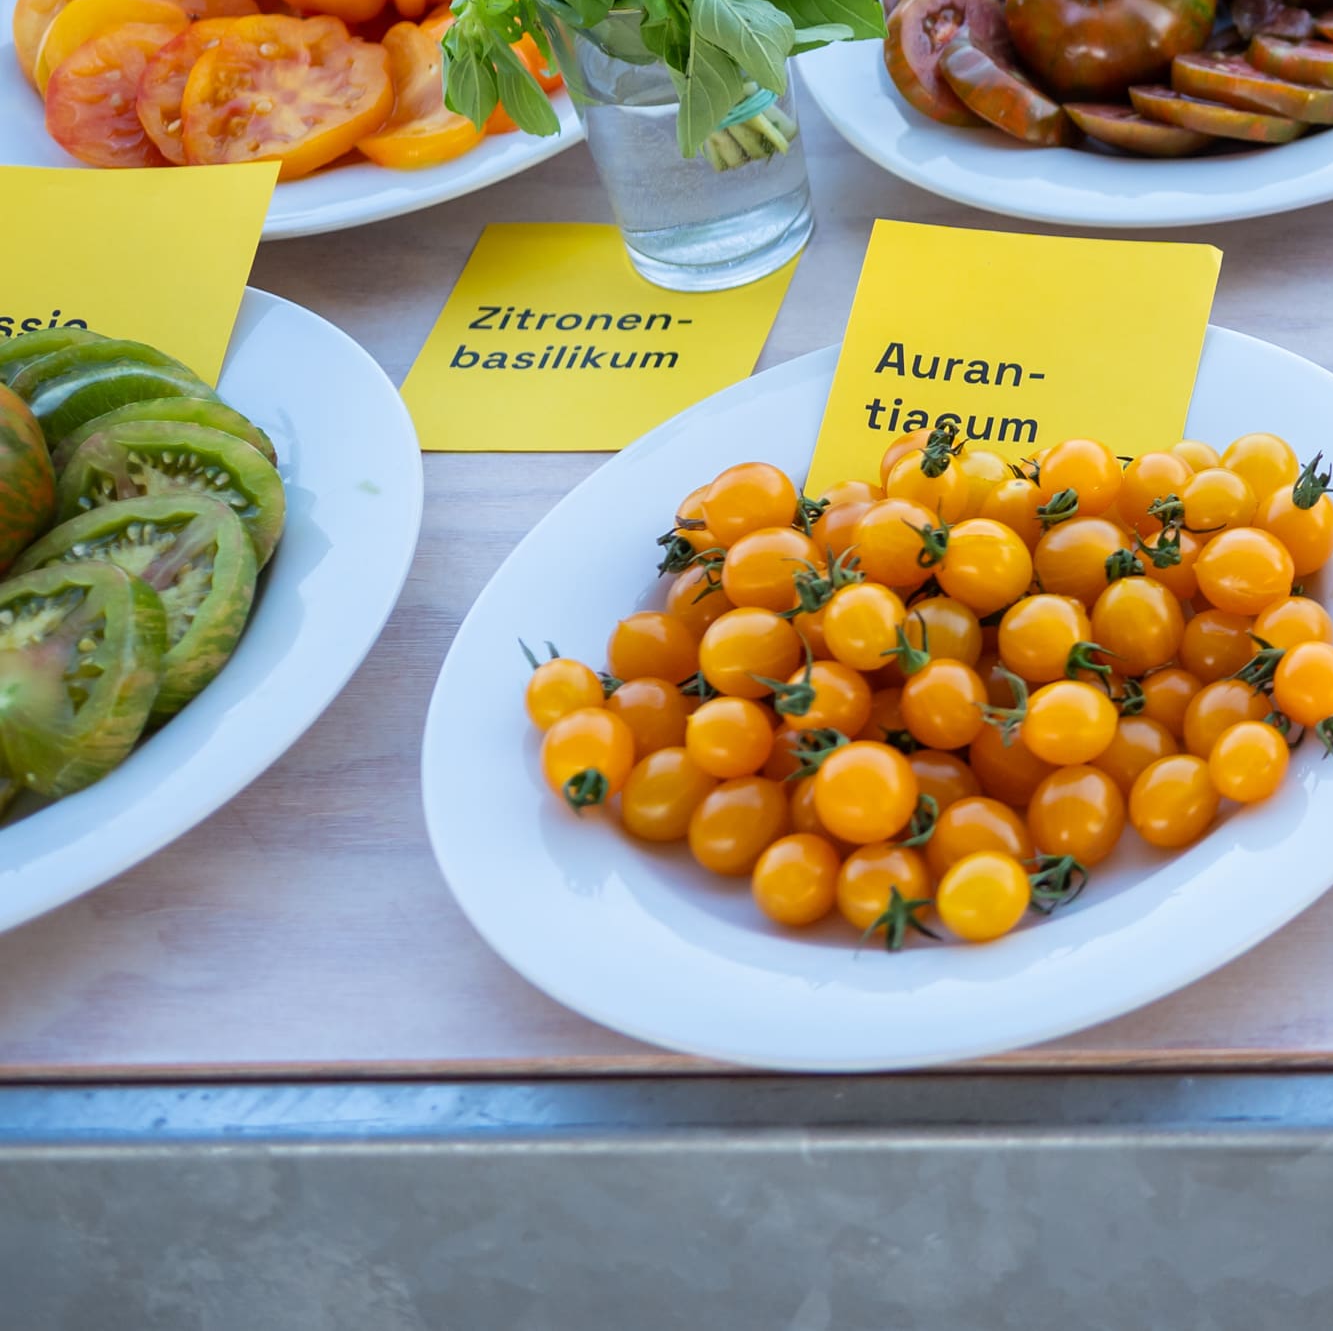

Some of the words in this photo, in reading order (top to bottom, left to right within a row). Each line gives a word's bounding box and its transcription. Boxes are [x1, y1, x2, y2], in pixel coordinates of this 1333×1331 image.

[467, 306, 693, 331] Zitronen-
[449, 344, 680, 370] basilikum
[873, 341, 1046, 387] Auran-
